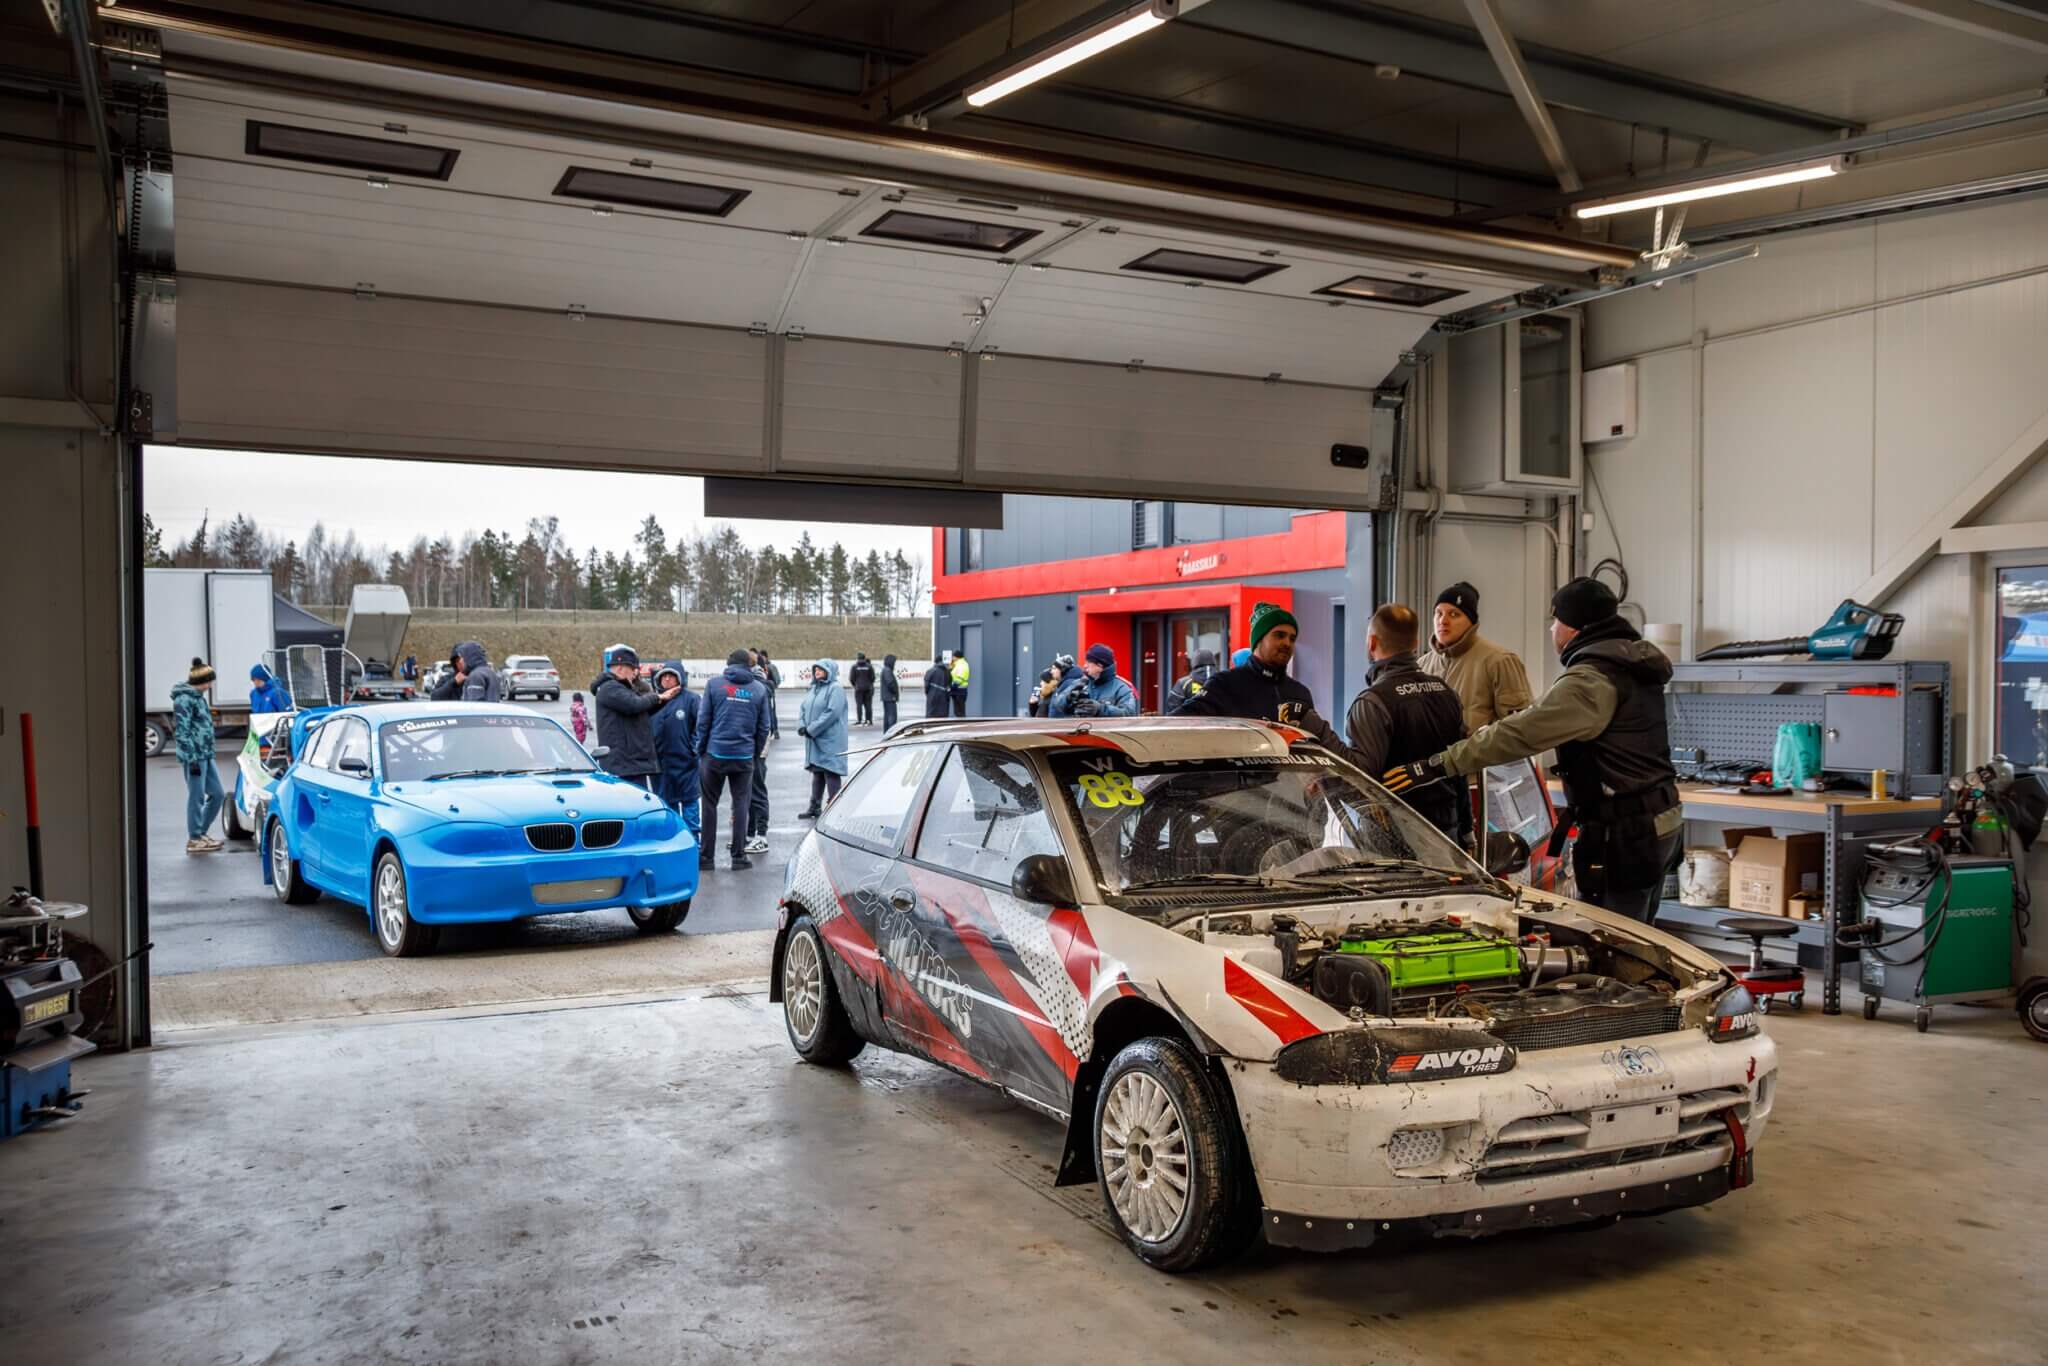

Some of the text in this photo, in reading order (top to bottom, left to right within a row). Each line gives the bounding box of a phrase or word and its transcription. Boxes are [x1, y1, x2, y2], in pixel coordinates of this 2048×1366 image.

[1078, 771, 1145, 808] 88
[1415, 1046, 1505, 1070] AVON
[1463, 1062, 1499, 1074] TYRES
